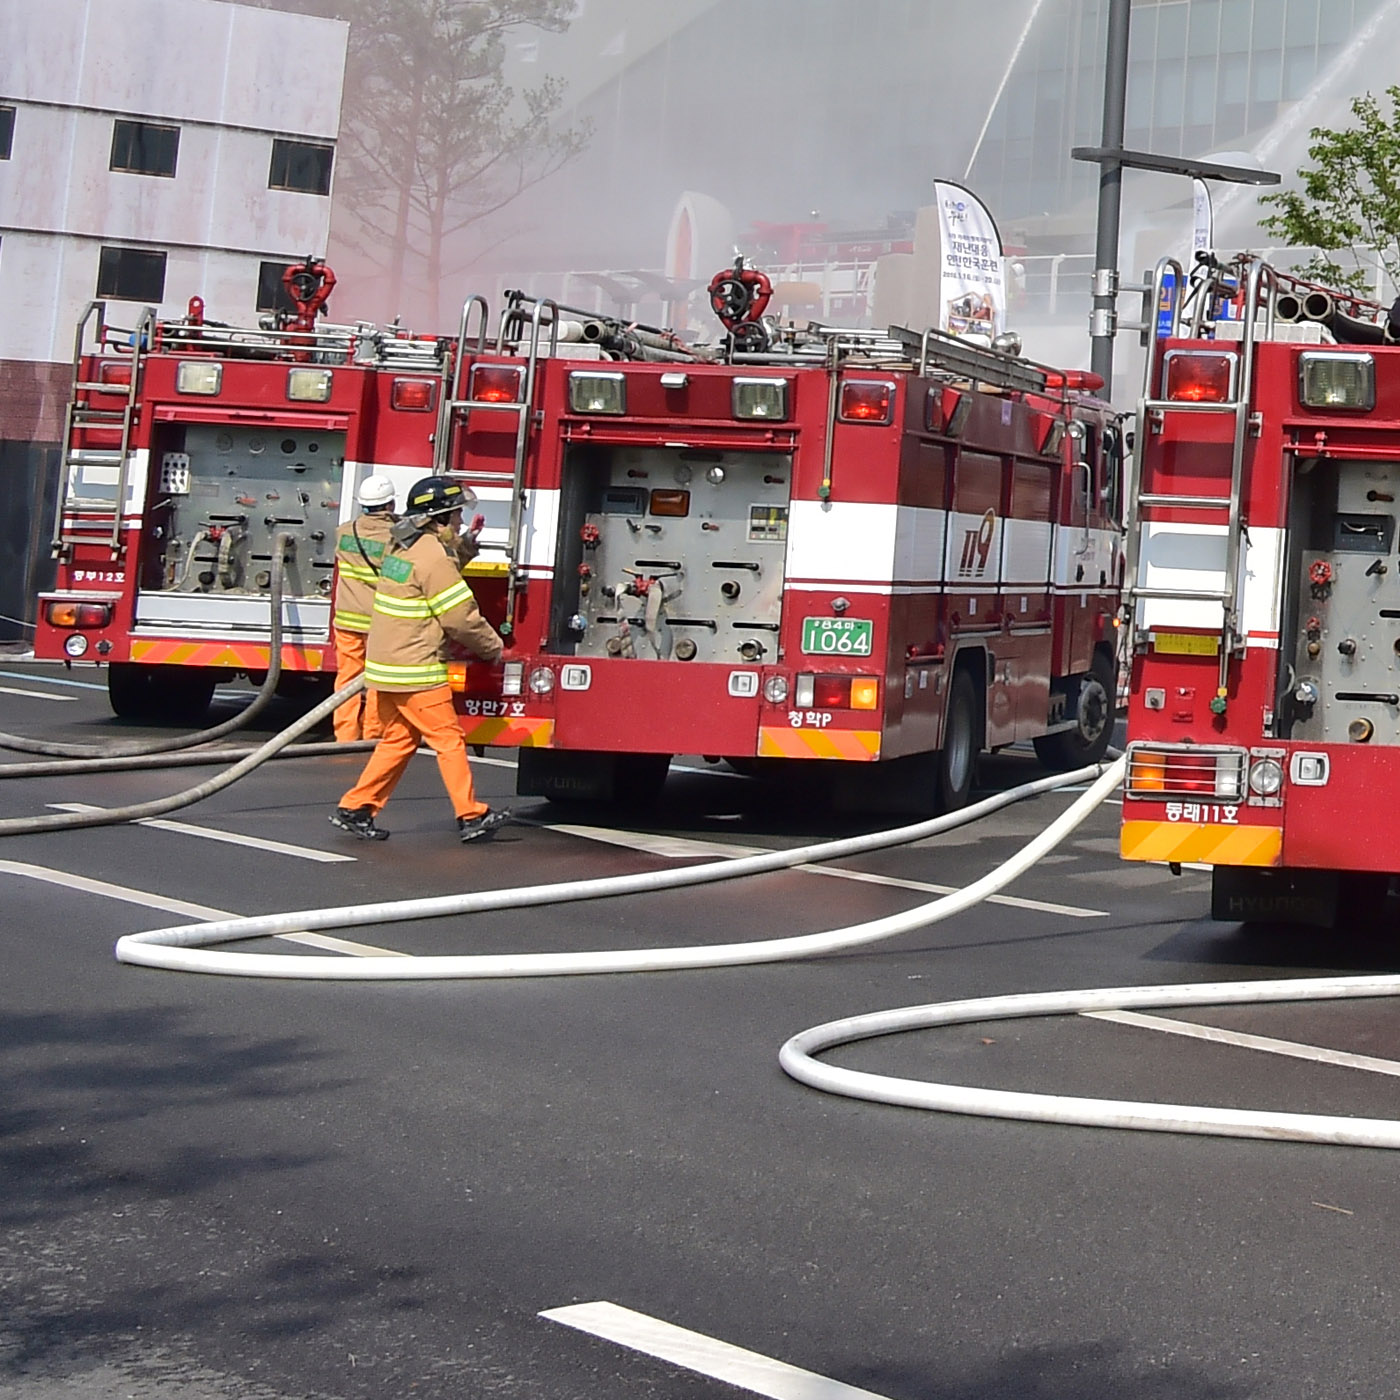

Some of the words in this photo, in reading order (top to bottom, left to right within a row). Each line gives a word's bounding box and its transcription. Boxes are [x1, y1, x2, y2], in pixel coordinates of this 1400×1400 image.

[959, 507, 995, 577] 119
[809, 630, 868, 653] 1064
[465, 699, 526, 717] 항만7호
[788, 711, 832, 728] 청학P
[1165, 802, 1239, 824] 동래11호
